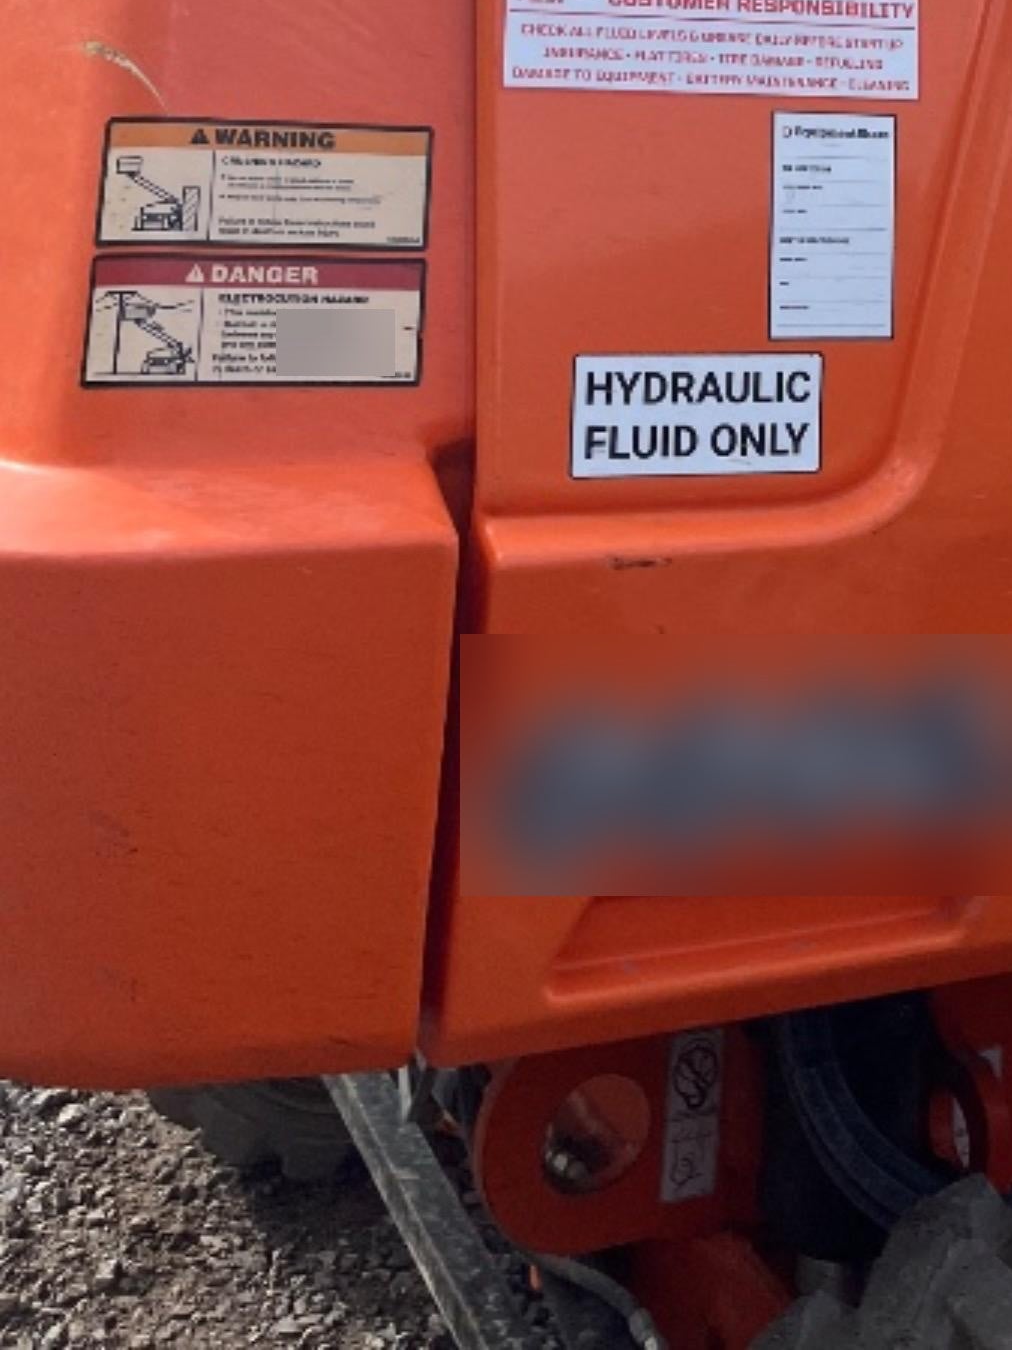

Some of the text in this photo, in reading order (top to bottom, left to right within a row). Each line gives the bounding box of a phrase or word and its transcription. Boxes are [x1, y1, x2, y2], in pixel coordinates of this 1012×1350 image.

[215, 128, 336, 149] WARNING
[211, 264, 319, 285] DANGER
[586, 370, 811, 405] HYDRAULIC
[584, 422, 810, 460] FLUID ONLY
